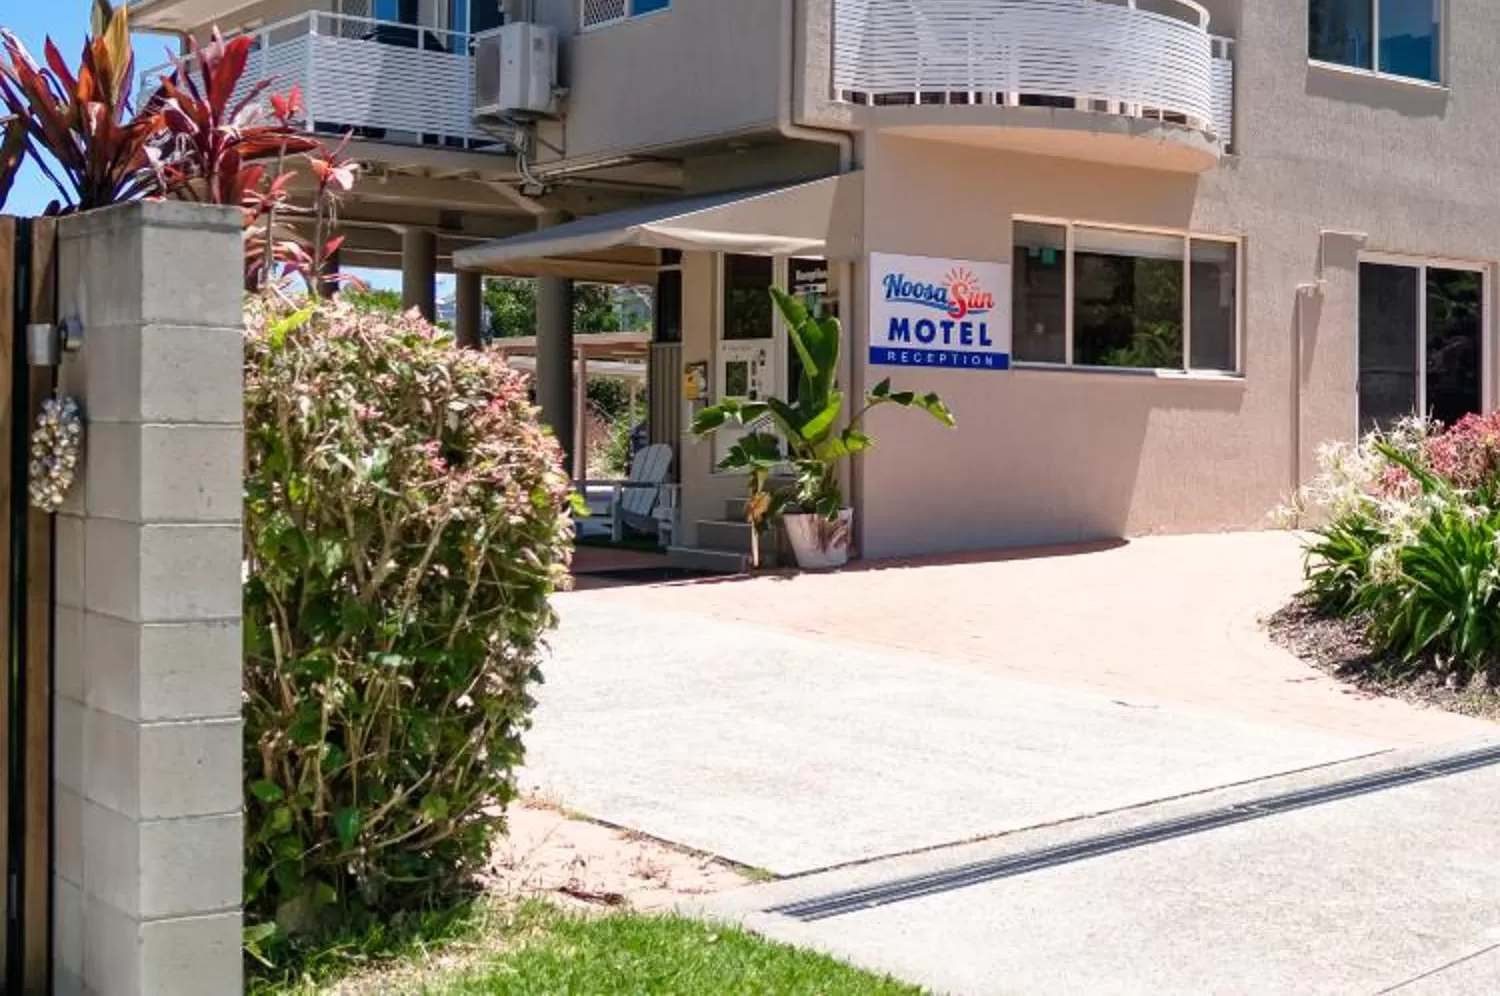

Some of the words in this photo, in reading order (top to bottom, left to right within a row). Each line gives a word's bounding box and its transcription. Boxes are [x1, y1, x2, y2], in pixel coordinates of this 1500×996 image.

[883, 274, 949, 304] Noosa
[948, 283, 995, 319] Sun
[888, 317, 992, 346] MOTEL
[887, 351, 993, 366] RECEPTION
